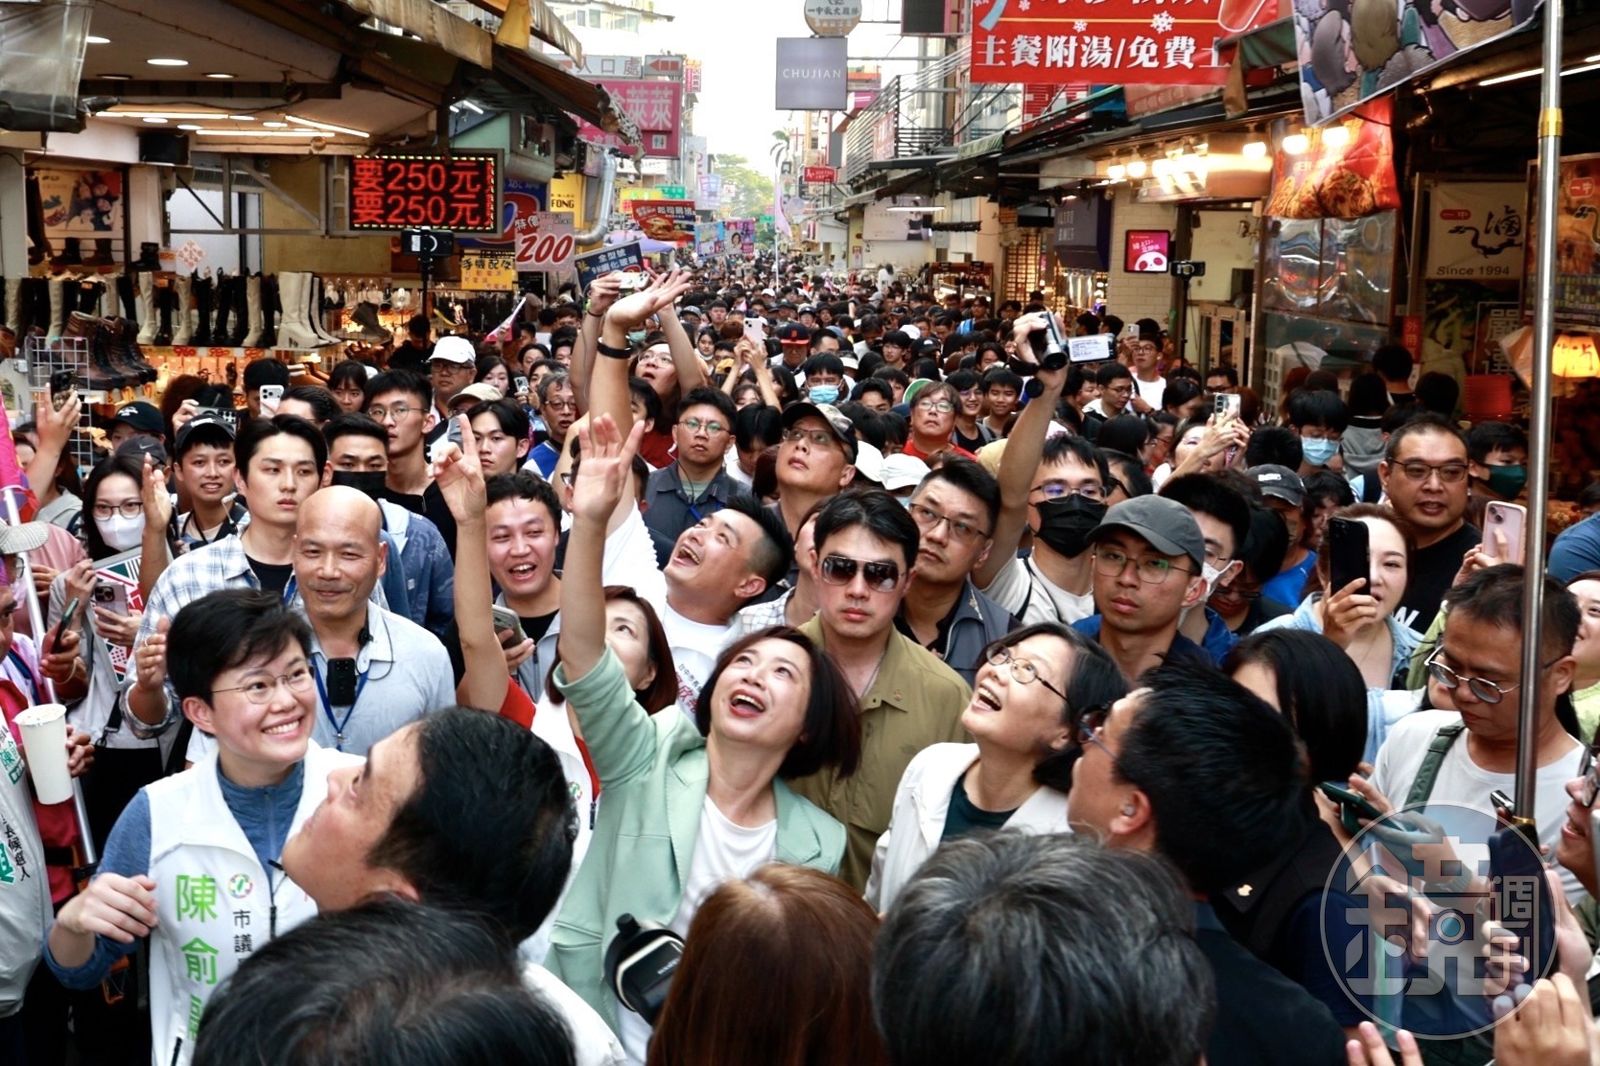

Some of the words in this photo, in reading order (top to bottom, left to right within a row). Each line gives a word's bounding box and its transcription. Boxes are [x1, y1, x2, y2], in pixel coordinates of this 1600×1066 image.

[782, 68, 842, 79] CHUJIAN
[515, 233, 574, 264] 200
[1436, 265, 1474, 276] Since
[1478, 265, 1510, 276] 1994
[232, 908, 253, 965] 市議
